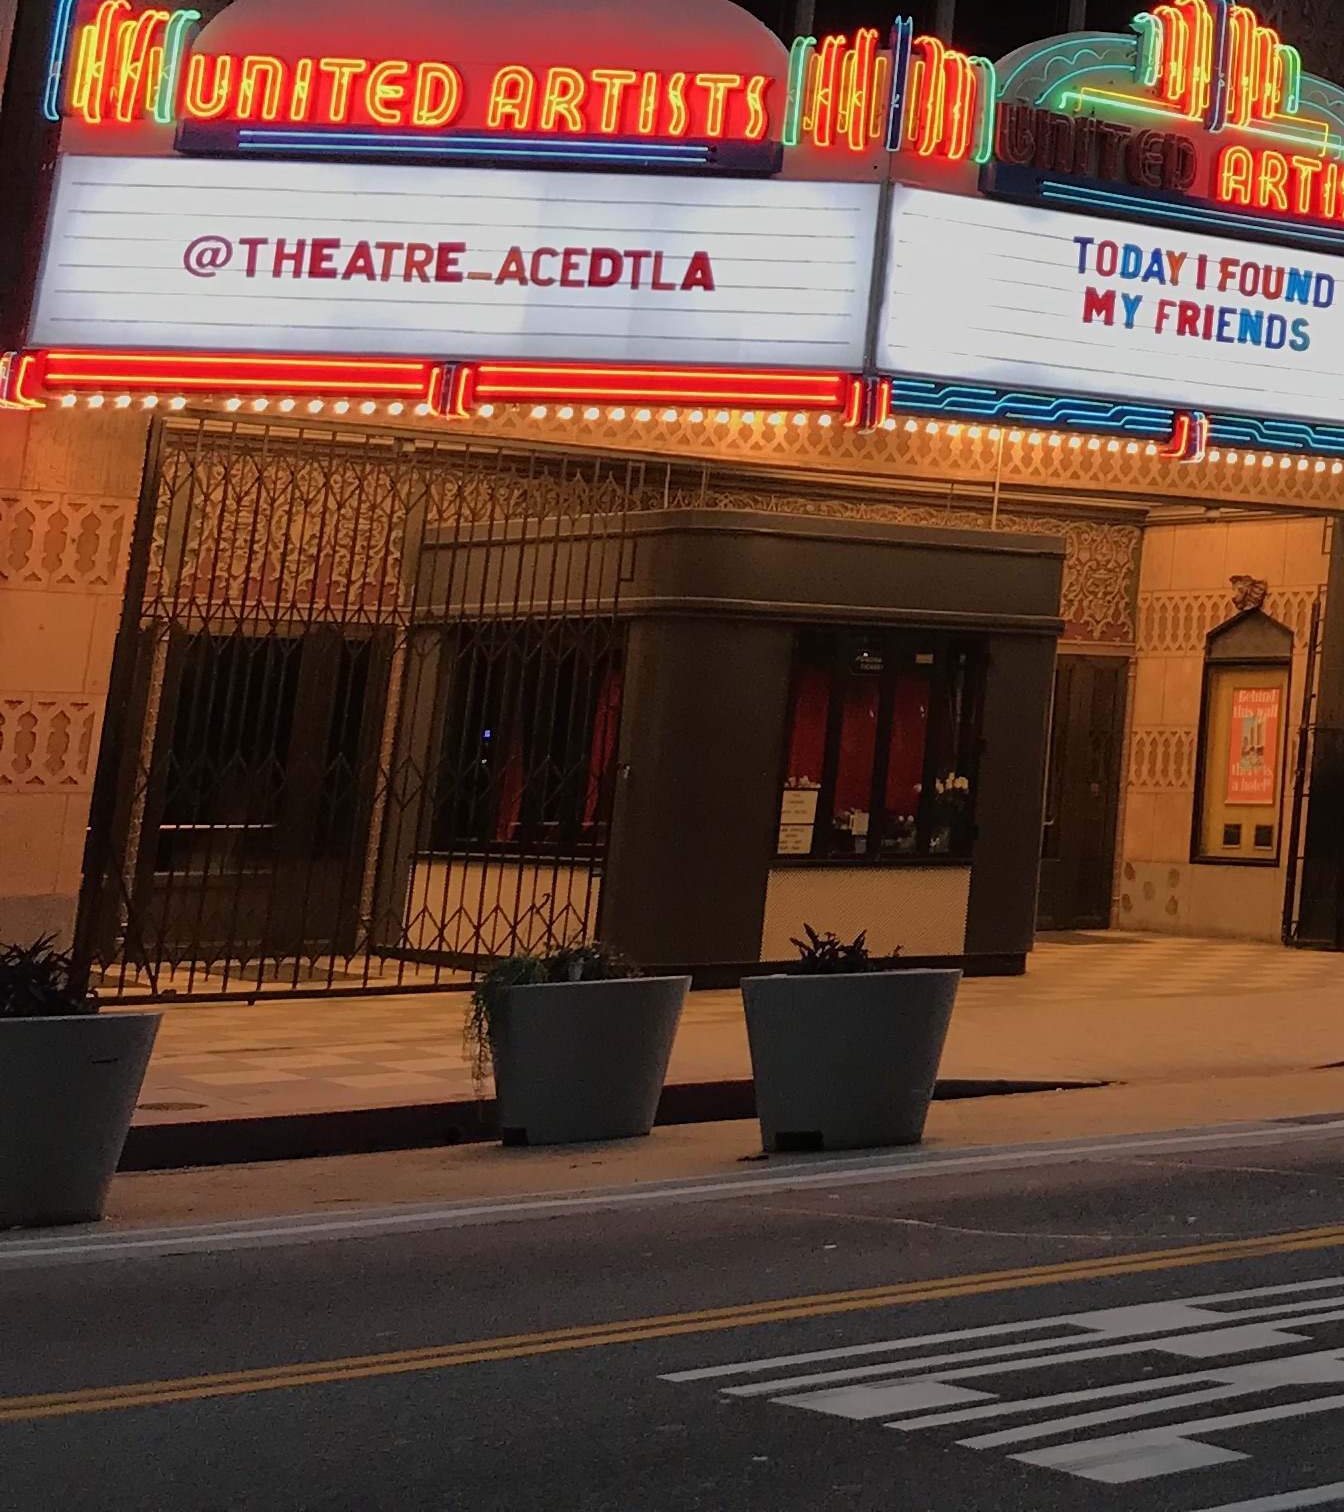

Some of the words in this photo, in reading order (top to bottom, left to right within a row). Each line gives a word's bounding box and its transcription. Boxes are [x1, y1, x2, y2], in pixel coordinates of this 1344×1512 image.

[183, 52, 462, 127] UNITED
[485, 63, 774, 140] ARTISTS
[1000, 101, 1198, 191] UNITED
[183, 234, 717, 292] @THEATRE_ACEDTLA
[1072, 235, 1188, 287] TODAY
[1195, 253, 1208, 290] I
[1217, 256, 1336, 308] FOUND
[1082, 286, 1144, 330] MY
[1154, 298, 1311, 352] FRIENDS
